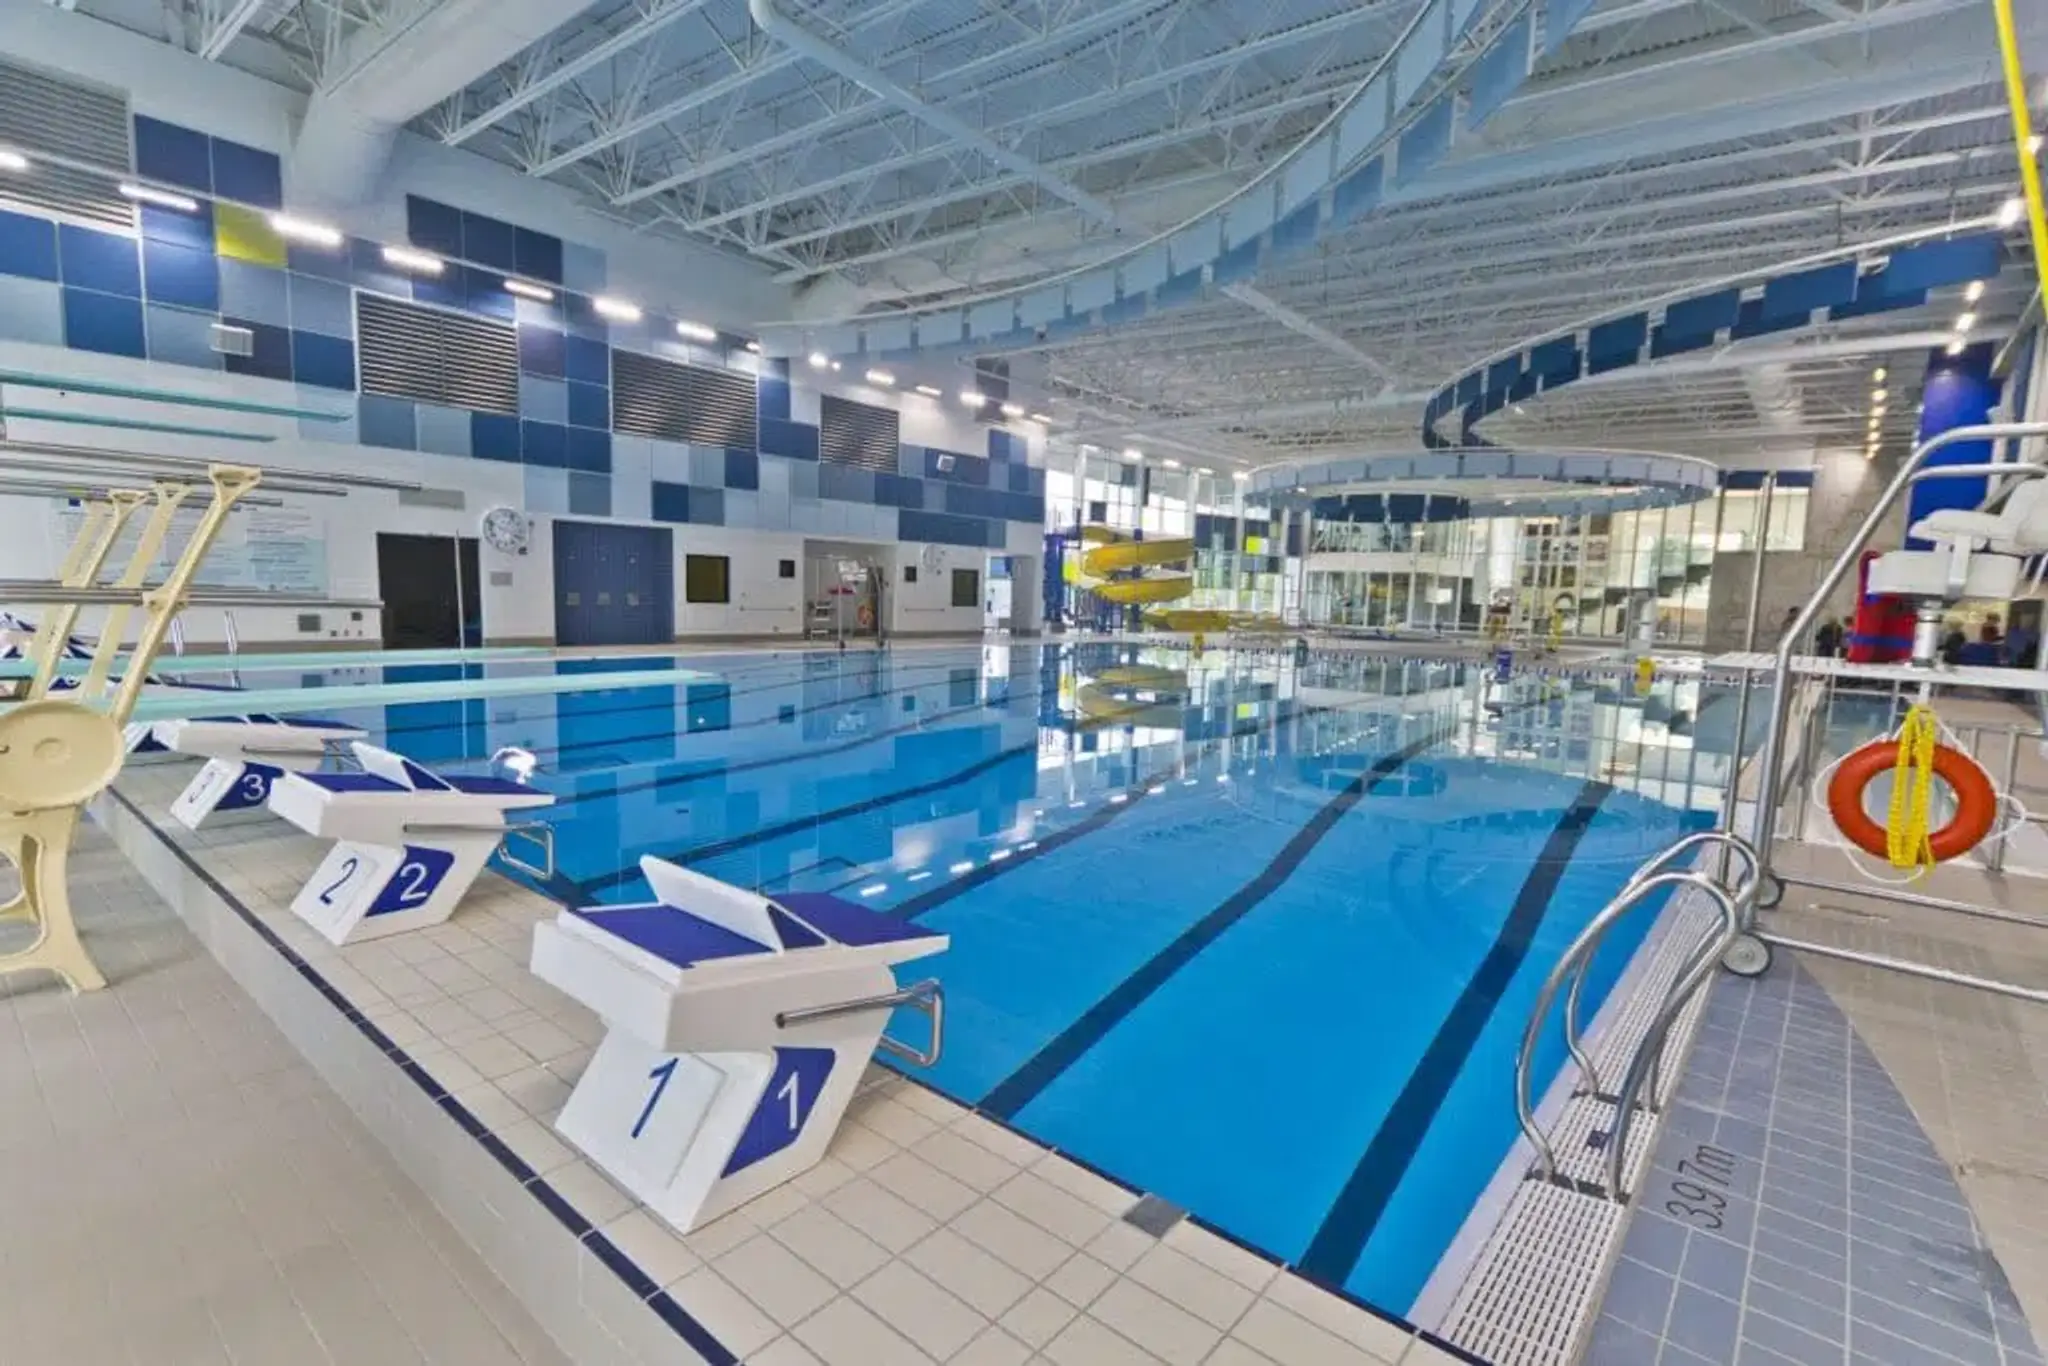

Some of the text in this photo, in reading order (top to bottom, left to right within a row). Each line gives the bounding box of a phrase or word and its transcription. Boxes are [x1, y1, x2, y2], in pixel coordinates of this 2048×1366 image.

[242, 774, 266, 802] 3
[319, 856, 359, 906] 2
[399, 861, 429, 902] 2
[631, 1057, 679, 1140] 1
[777, 1071, 800, 1131] 1
